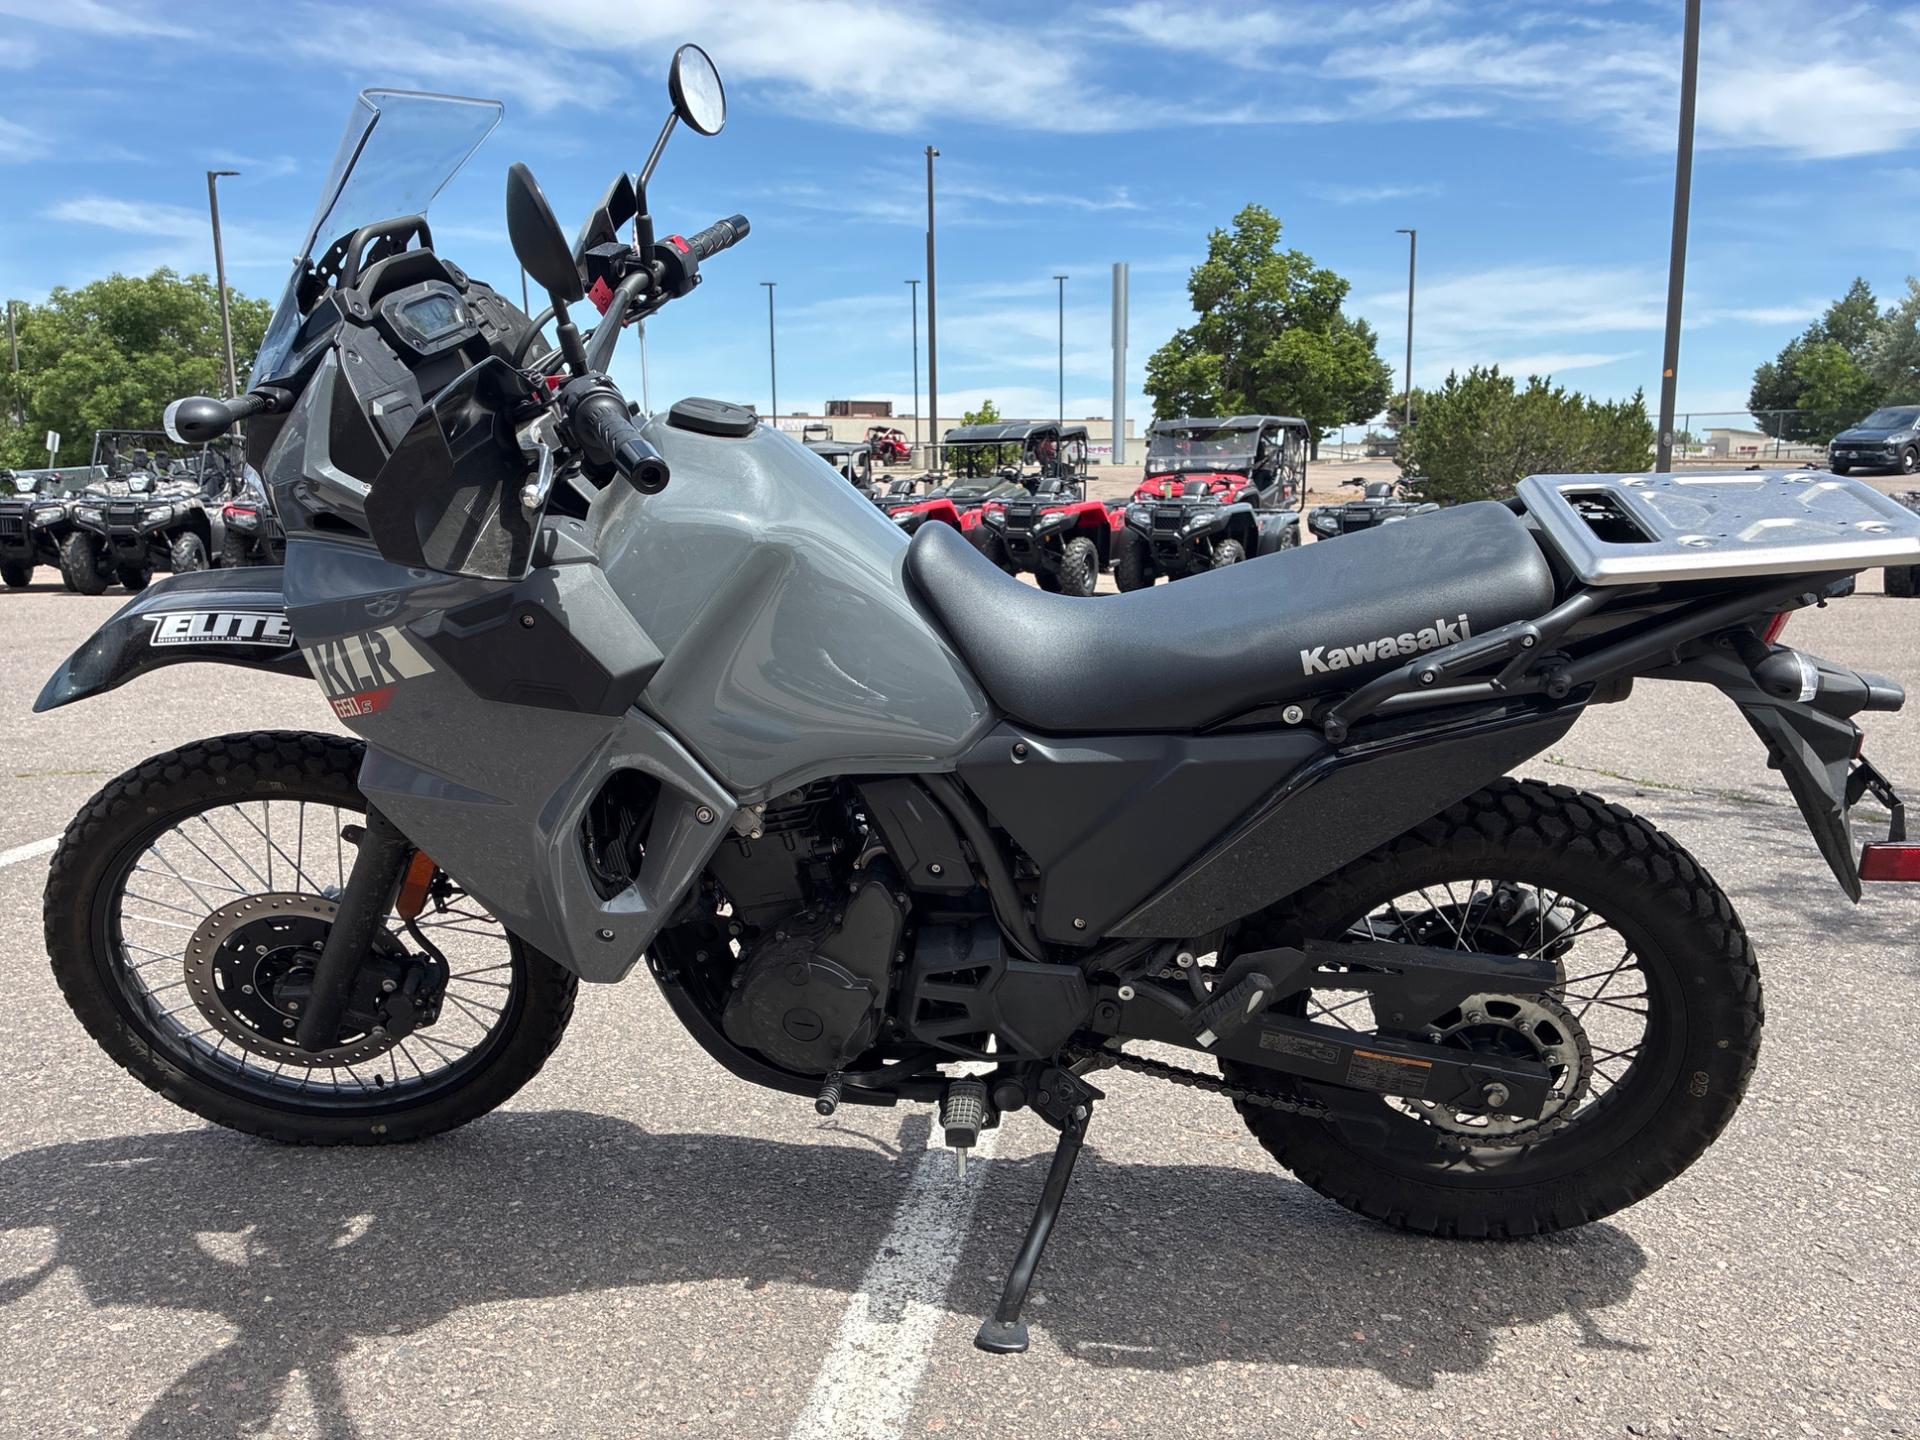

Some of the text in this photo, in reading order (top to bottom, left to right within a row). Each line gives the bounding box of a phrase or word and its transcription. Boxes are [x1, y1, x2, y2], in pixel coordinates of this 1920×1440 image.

[158, 614, 291, 637] ELITE
[1300, 614, 1471, 675] Kawasaki
[310, 630, 406, 697] KLR
[333, 697, 361, 718] 650
